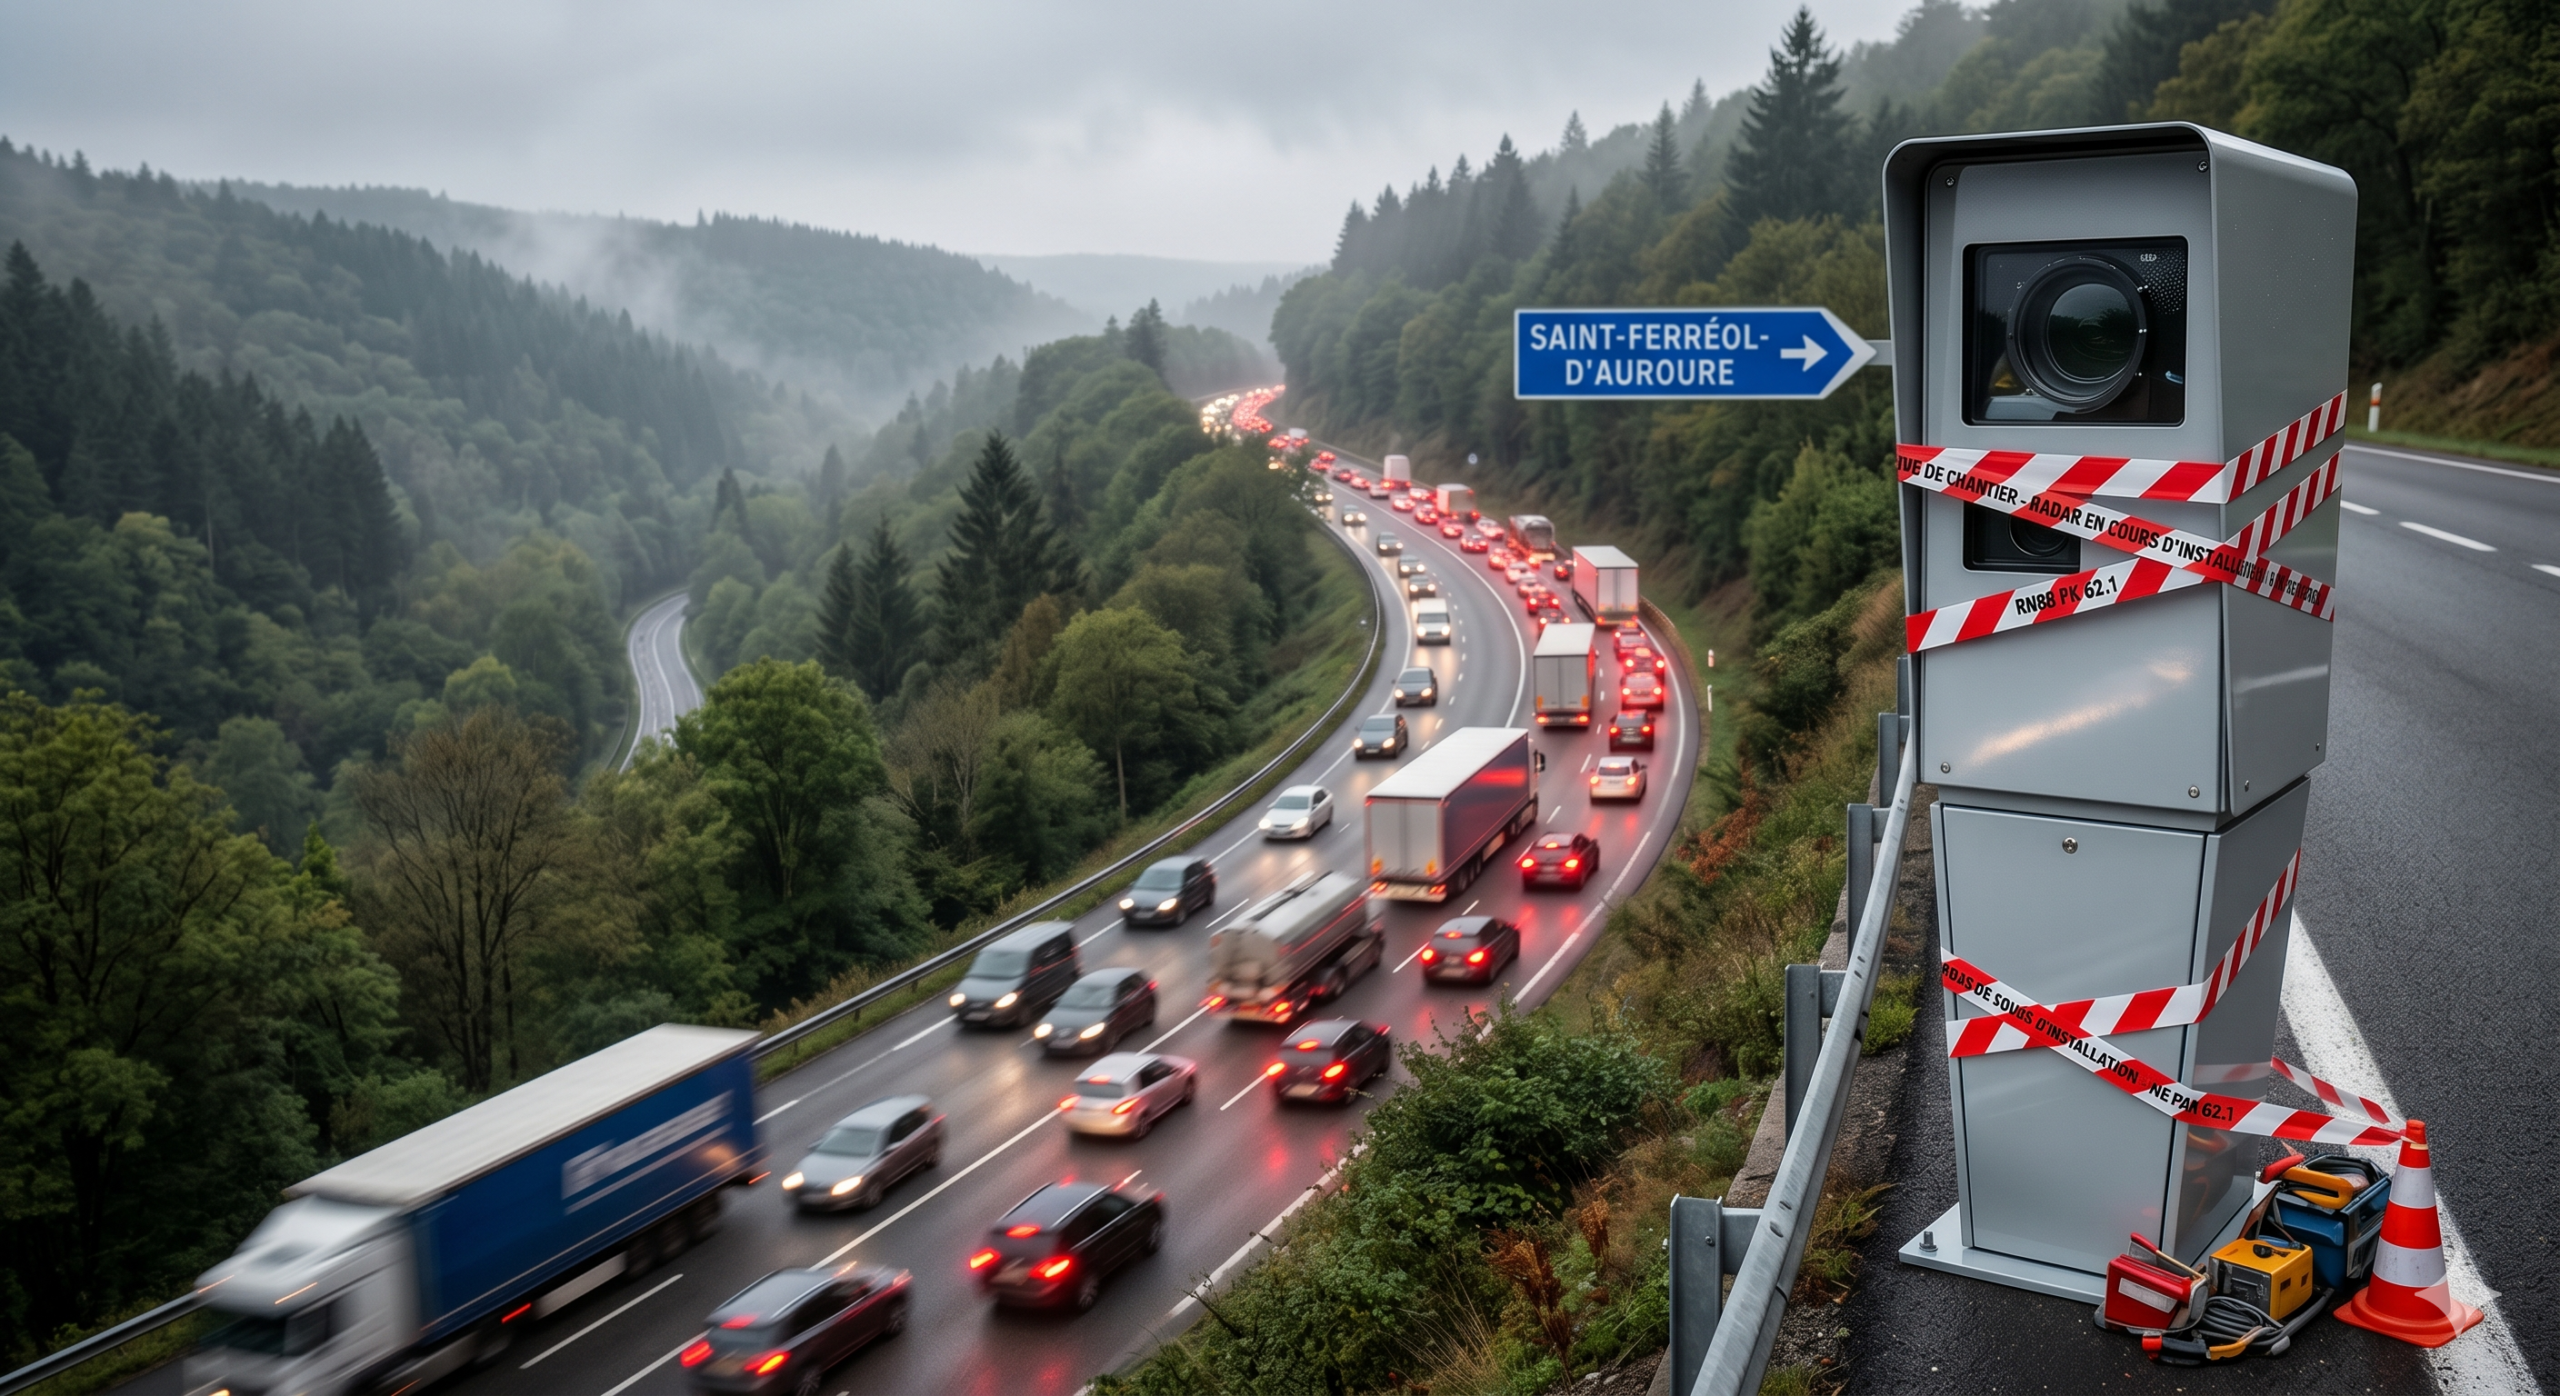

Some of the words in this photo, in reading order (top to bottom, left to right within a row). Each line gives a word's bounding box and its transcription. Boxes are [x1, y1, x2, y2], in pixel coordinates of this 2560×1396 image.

[1530, 316, 1770, 351] SAINT-FERRÉOL-
[1565, 358, 1735, 386] D'AUROURE
[1923, 463, 1946, 482] DE
[1946, 470, 2019, 505] CHANTIER
[2028, 496, 2083, 528] RADAR
[2083, 512, 2106, 532] EN
[2107, 520, 2160, 549] COURS
[2015, 590, 2057, 616] RN88
[2059, 584, 2082, 606] PK
[2084, 575, 2118, 599] 62.1
[1973, 982, 1993, 1002] DE
[2034, 1017, 2140, 1085] D'INSTALLATION
[2148, 1082, 2172, 1103] NE
[2201, 1102, 2234, 1122] 62.1
